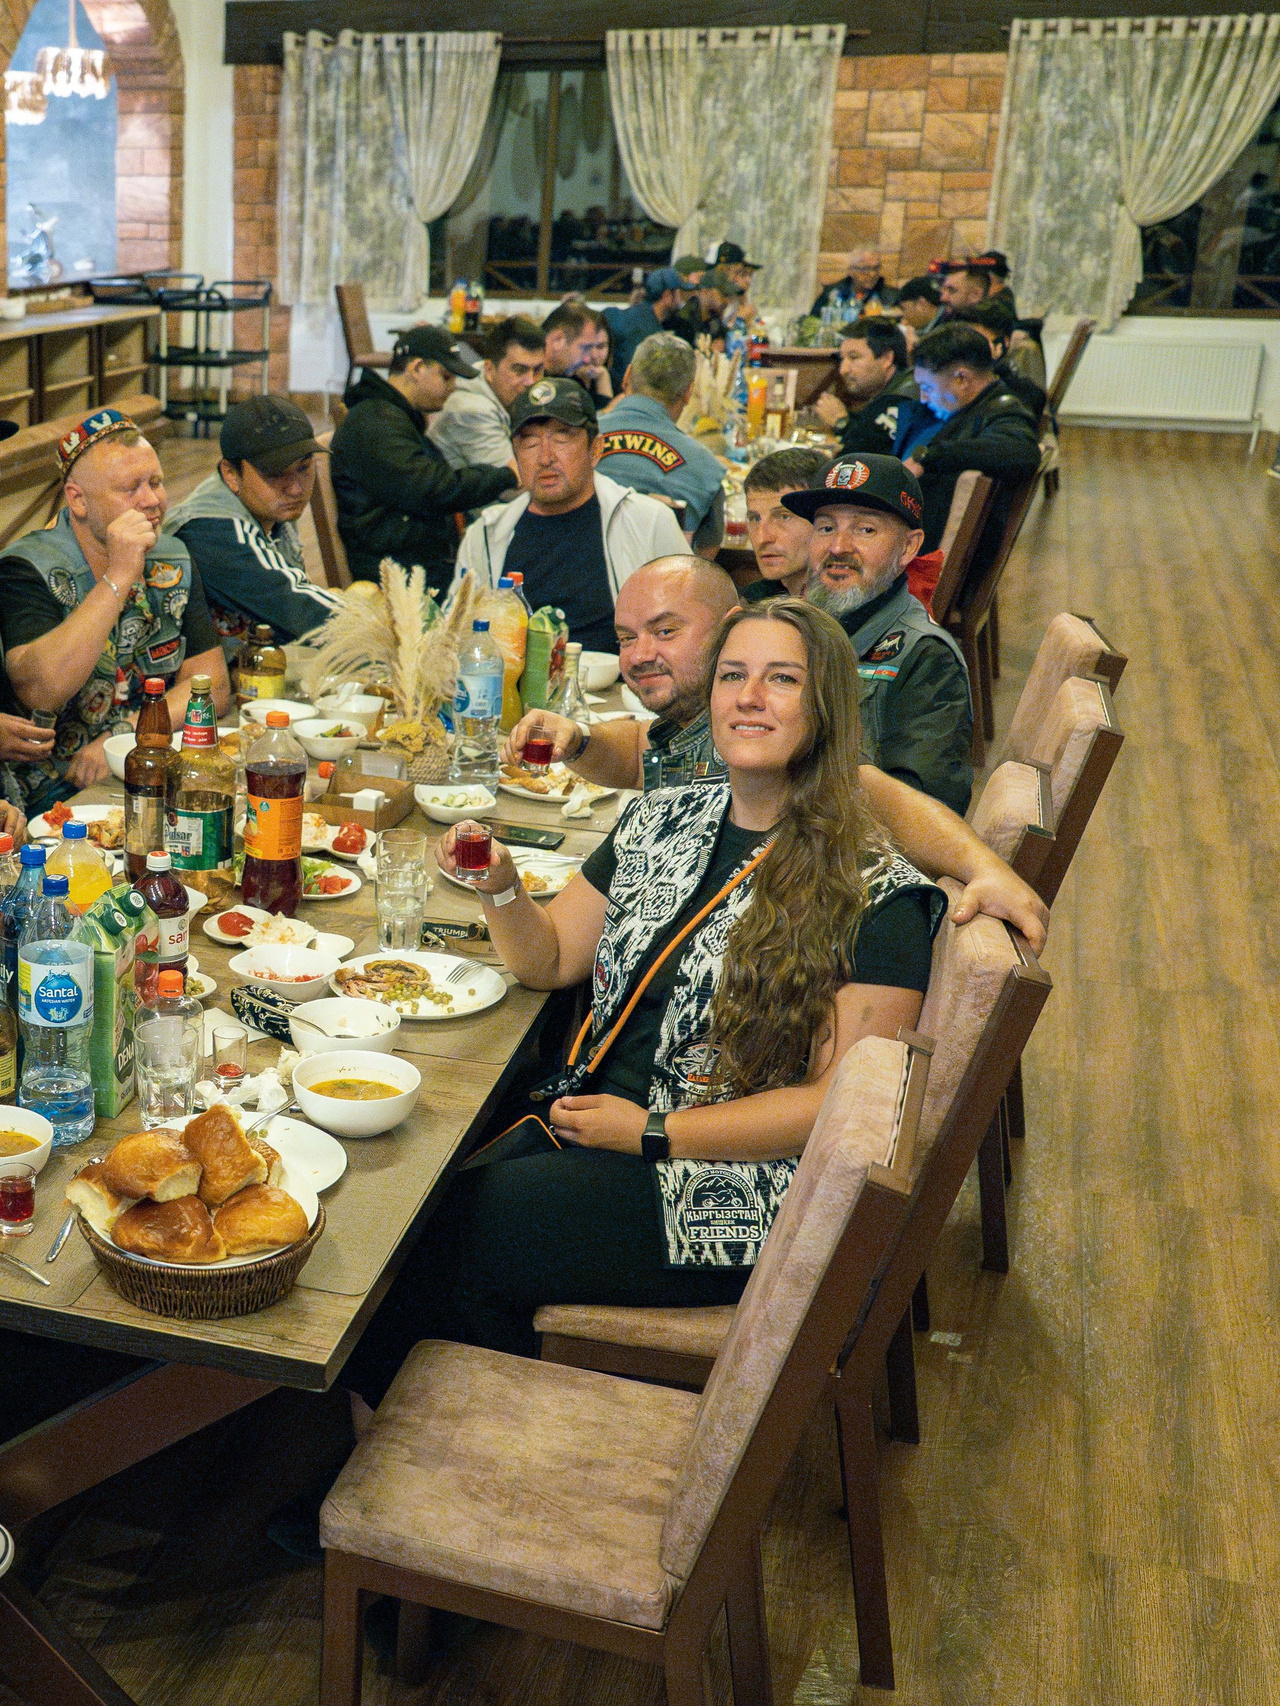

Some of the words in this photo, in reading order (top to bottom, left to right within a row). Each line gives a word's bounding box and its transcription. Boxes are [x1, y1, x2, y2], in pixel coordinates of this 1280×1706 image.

[38, 985, 78, 998] Santal
[686, 1209, 758, 1222] КЫРГЫЗСТАН
[689, 1225, 759, 1239] FRIENDS
